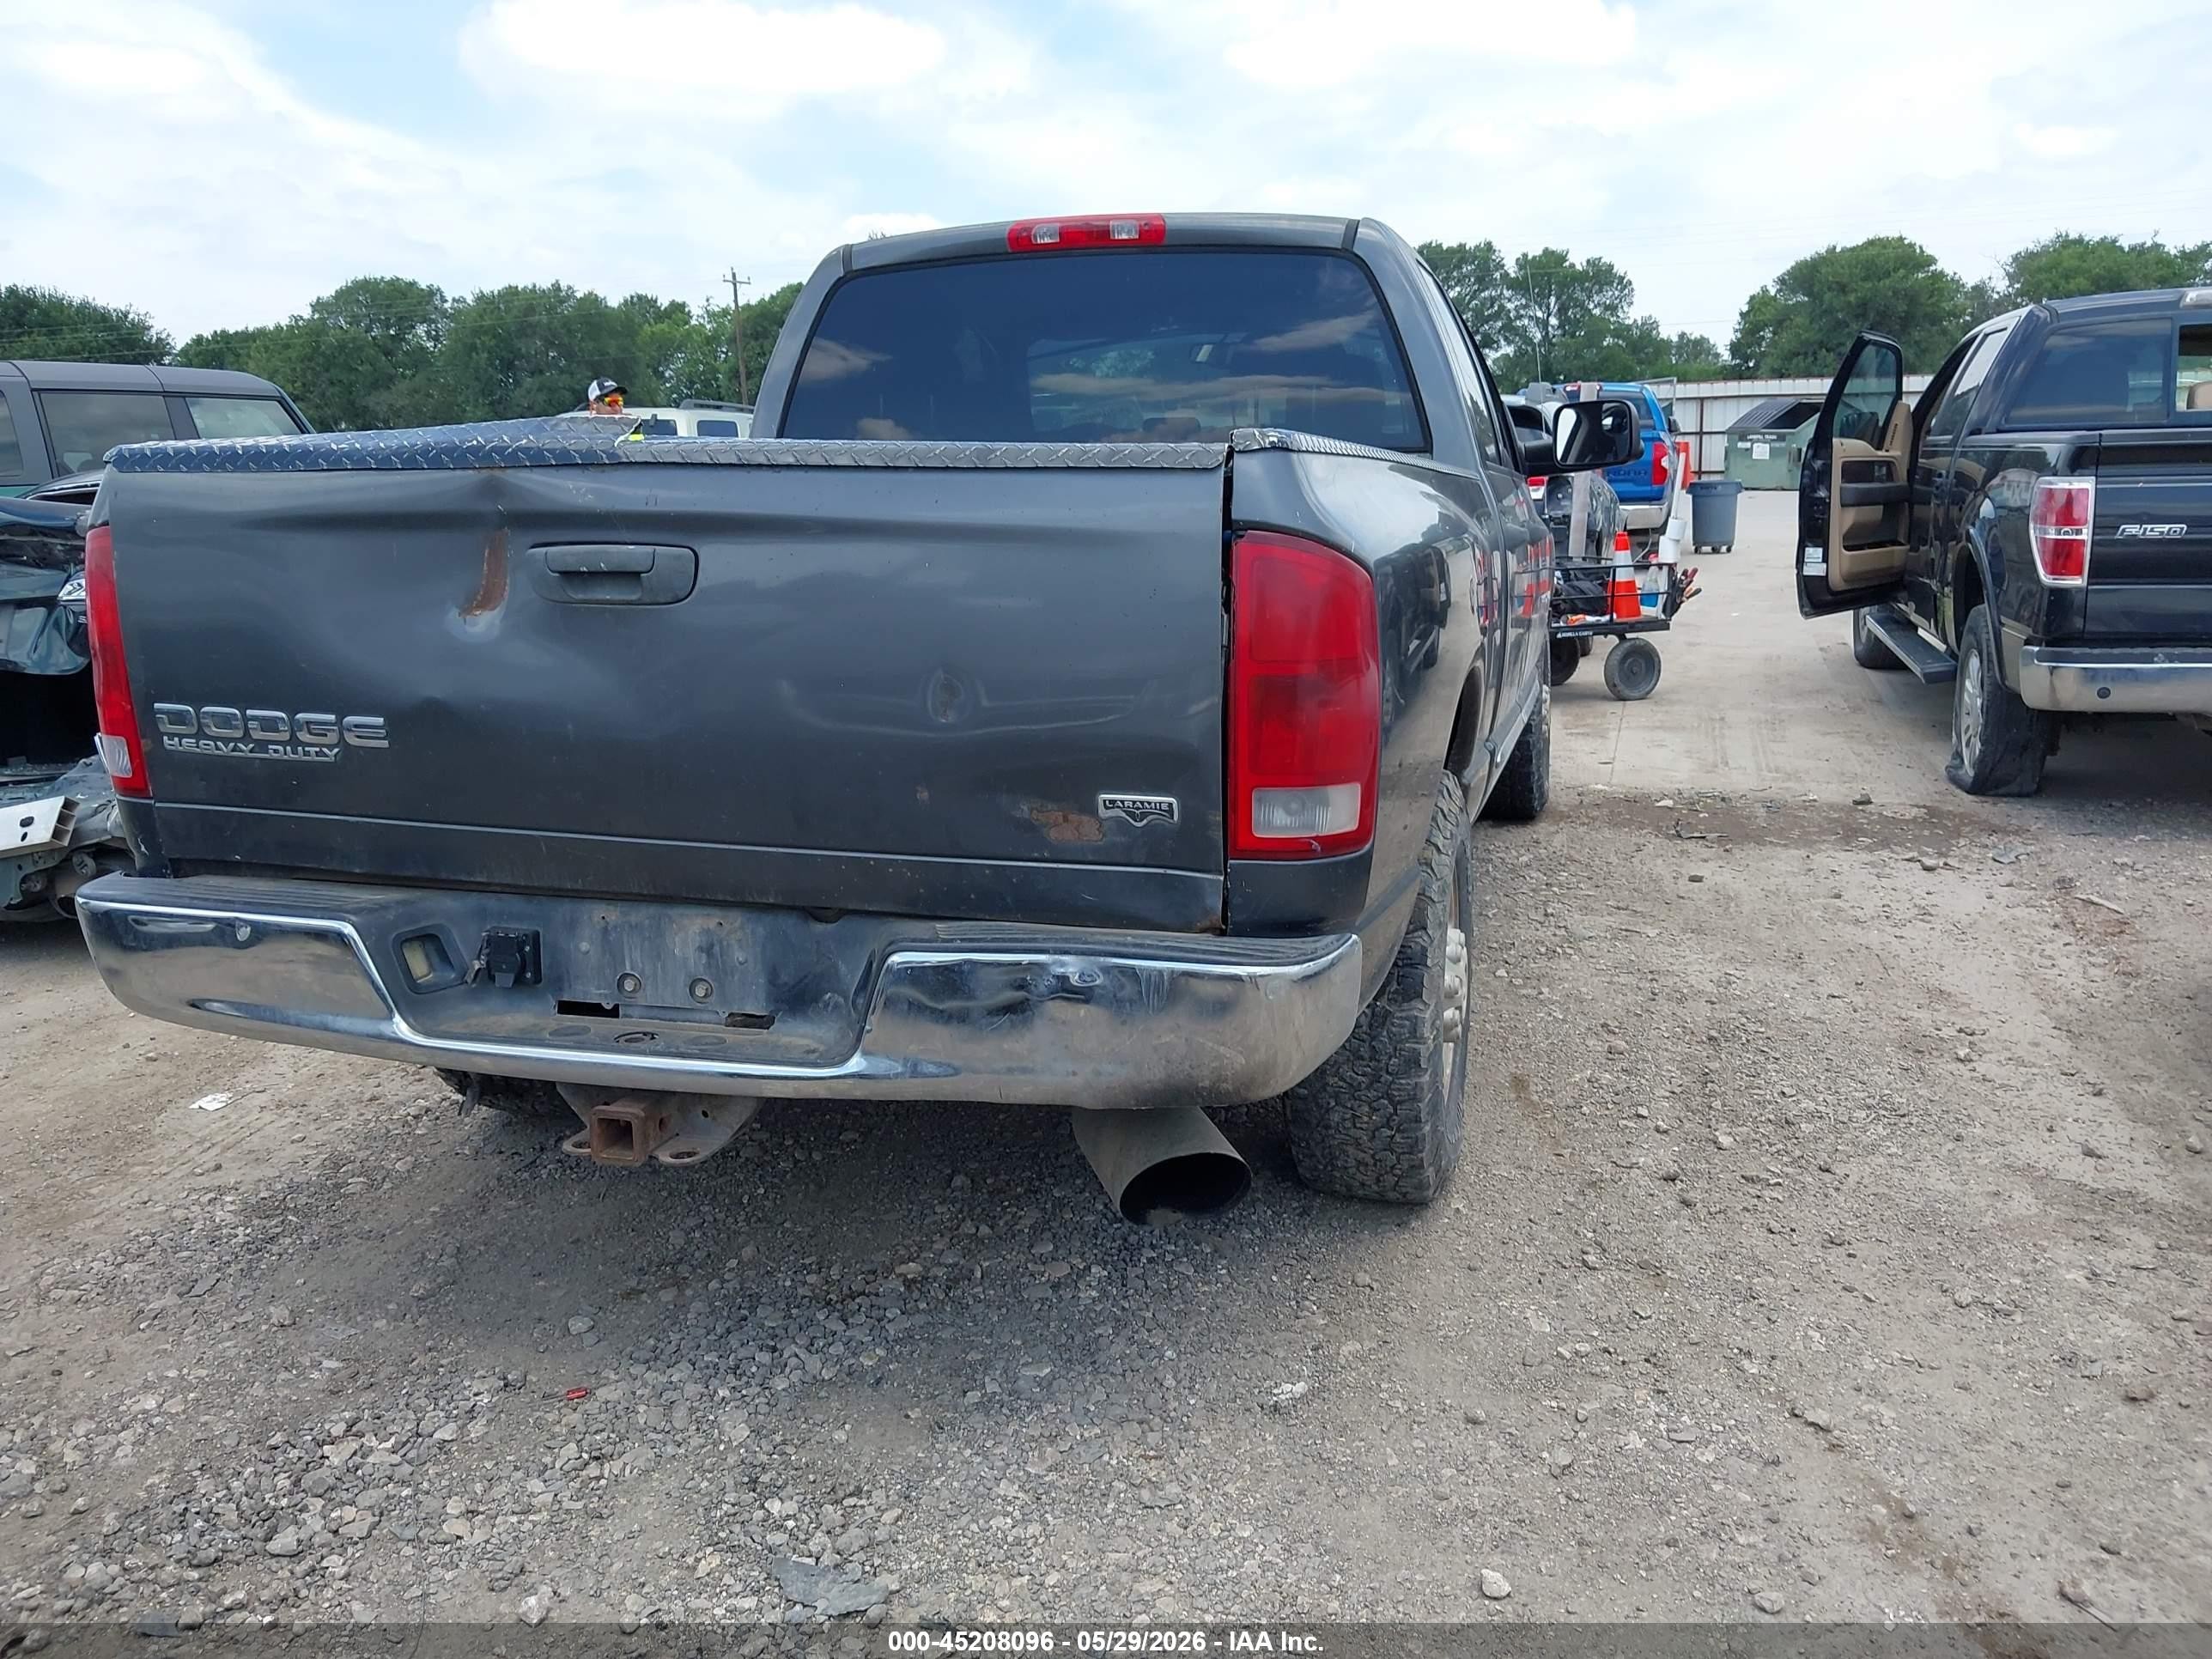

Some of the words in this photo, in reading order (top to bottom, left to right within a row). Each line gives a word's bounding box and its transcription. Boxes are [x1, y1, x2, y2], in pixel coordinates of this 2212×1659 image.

[2115, 525, 2187, 538] F-150
[153, 702, 389, 748] DODGE
[163, 736, 255, 754] HEAVY
[267, 744, 340, 762] DUTY
[1105, 799, 1170, 811] LARAMIE
